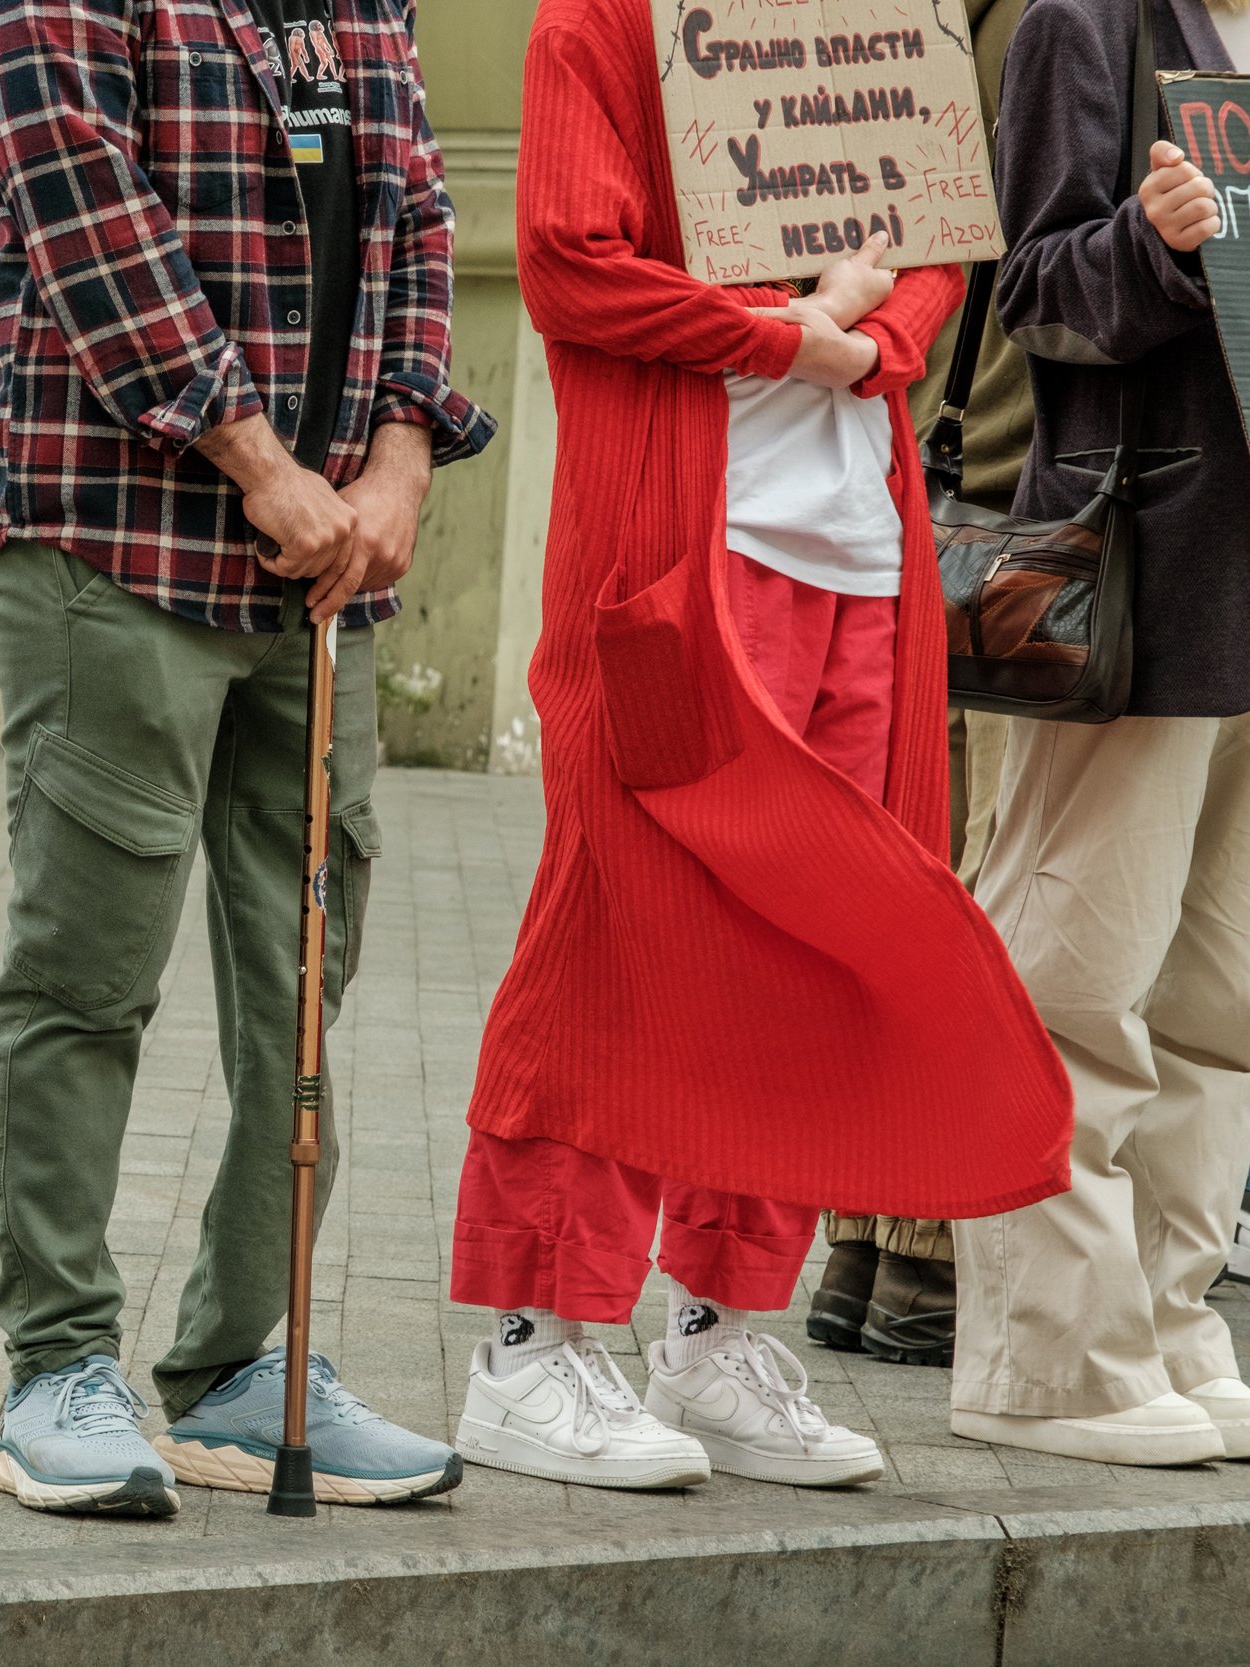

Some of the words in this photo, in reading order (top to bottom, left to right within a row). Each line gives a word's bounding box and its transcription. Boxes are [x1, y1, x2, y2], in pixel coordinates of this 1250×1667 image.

[879, 155, 907, 190] В
[923, 167, 988, 204] FREE
[694, 220, 743, 248] FREE
